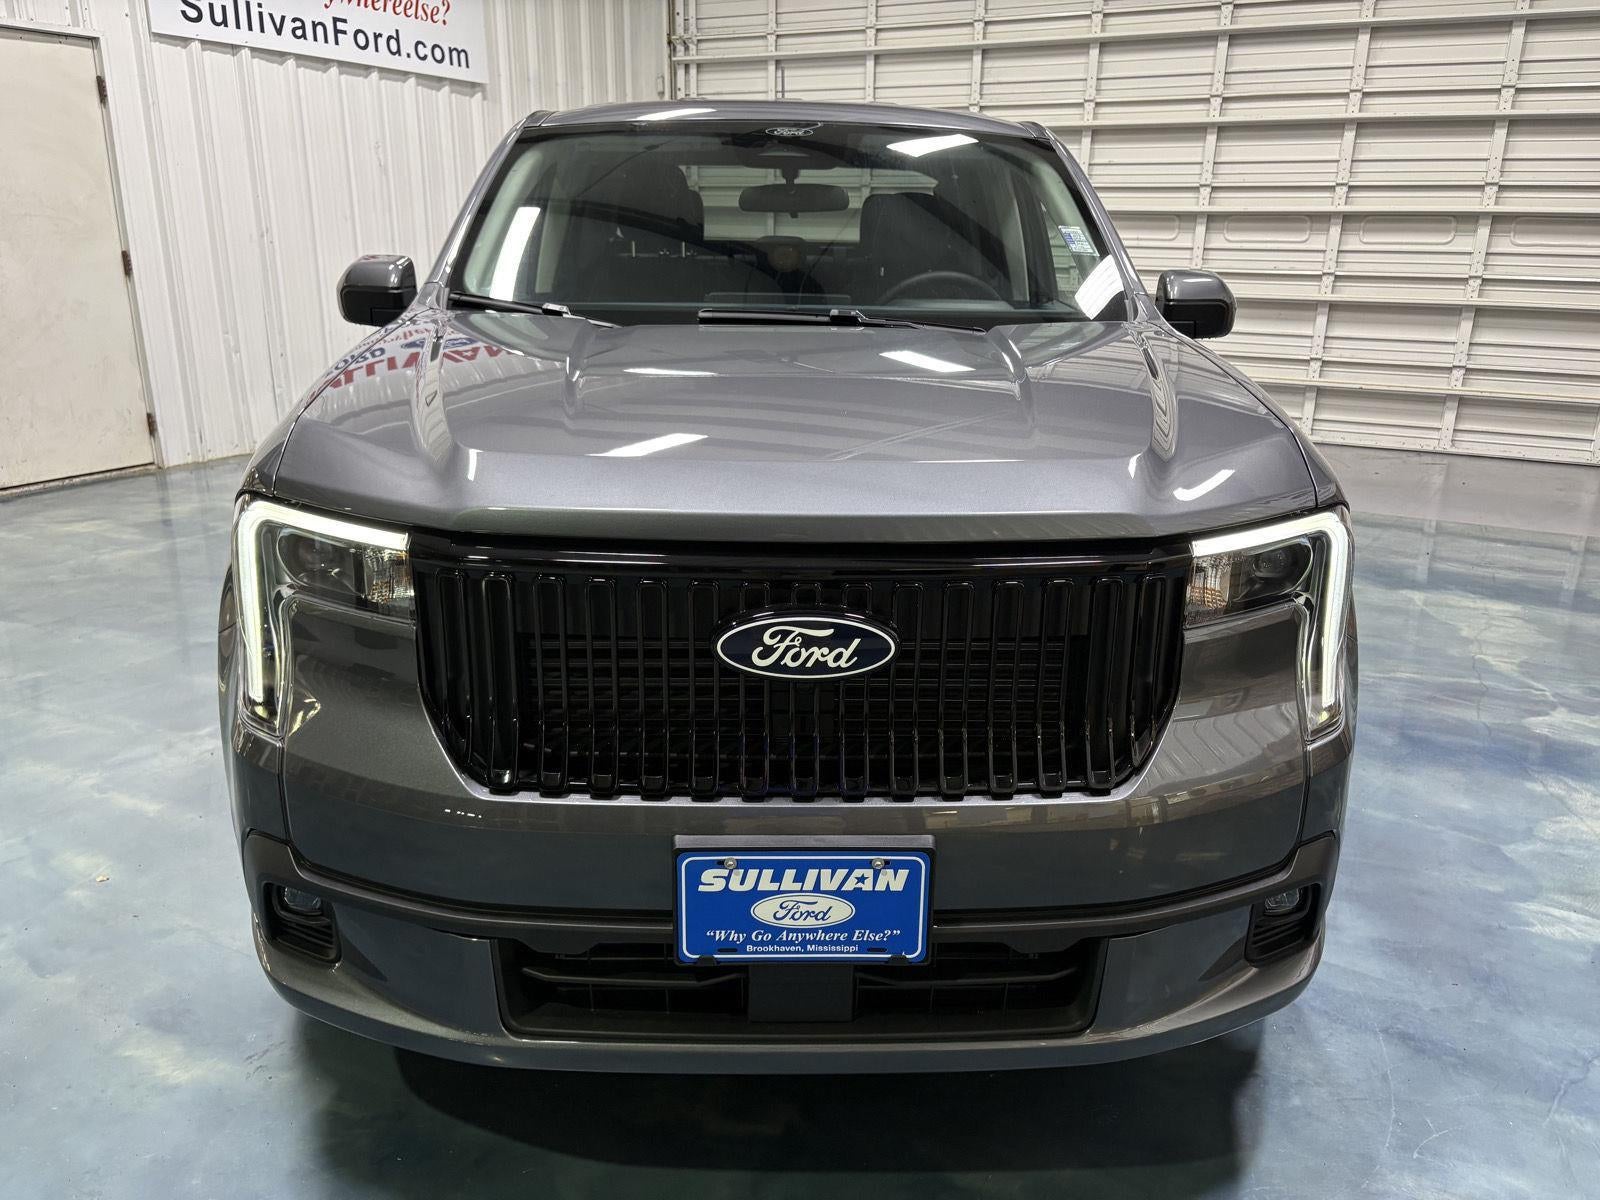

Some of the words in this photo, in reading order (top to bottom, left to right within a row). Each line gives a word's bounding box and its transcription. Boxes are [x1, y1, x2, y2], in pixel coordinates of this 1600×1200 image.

[324, 0, 451, 25] hereelse?
[180, 0, 470, 69] SullivanFord.com
[751, 625, 862, 668] Ford
[698, 868, 910, 892] SULLIVAN
[772, 899, 834, 922] Ford
[706, 929, 747, 944] “Why
[751, 929, 772, 942] Go
[776, 929, 849, 944] Anywhere
[852, 929, 901, 942] Else?”
[746, 944, 805, 953] Brookhaven,
[806, 944, 859, 953] Mississippi
